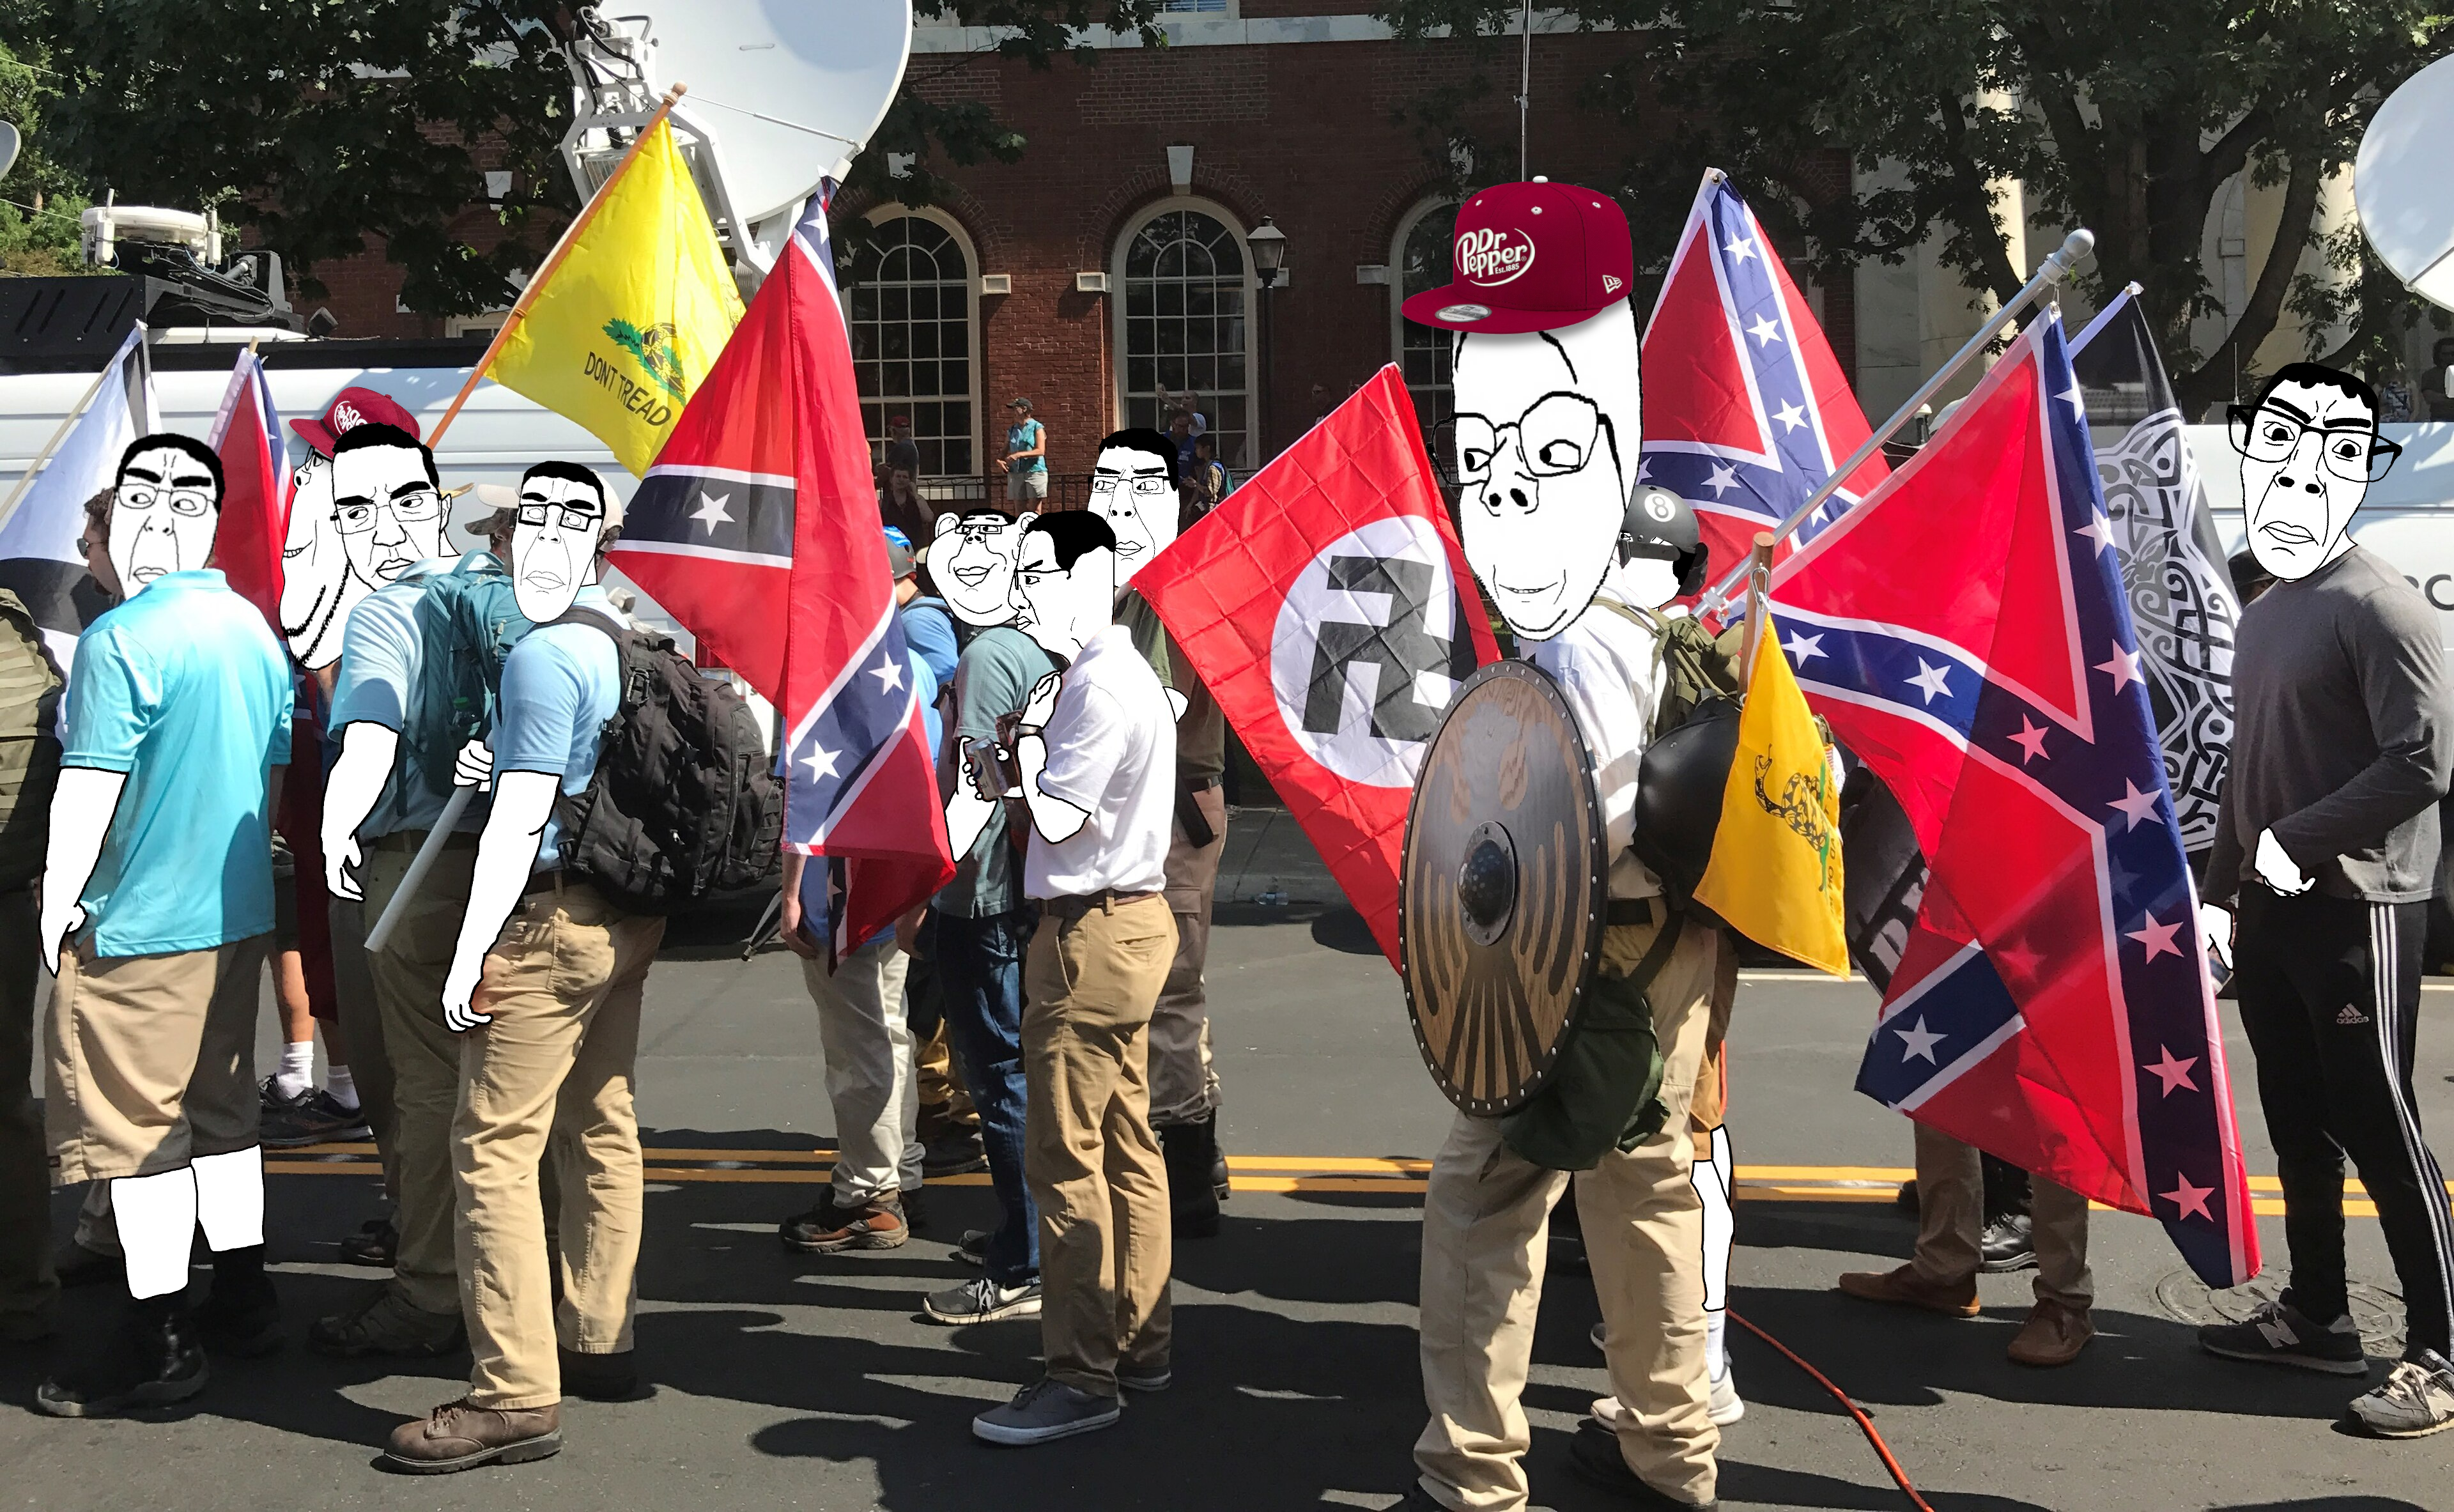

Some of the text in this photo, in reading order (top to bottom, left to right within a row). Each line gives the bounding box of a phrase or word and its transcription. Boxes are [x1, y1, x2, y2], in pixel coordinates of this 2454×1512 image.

[1456, 231, 1527, 279] Pepper
[1476, 228, 1507, 253] Dr
[584, 351, 672, 426] DONT TREAD
[1653, 496, 1669, 518] 8
